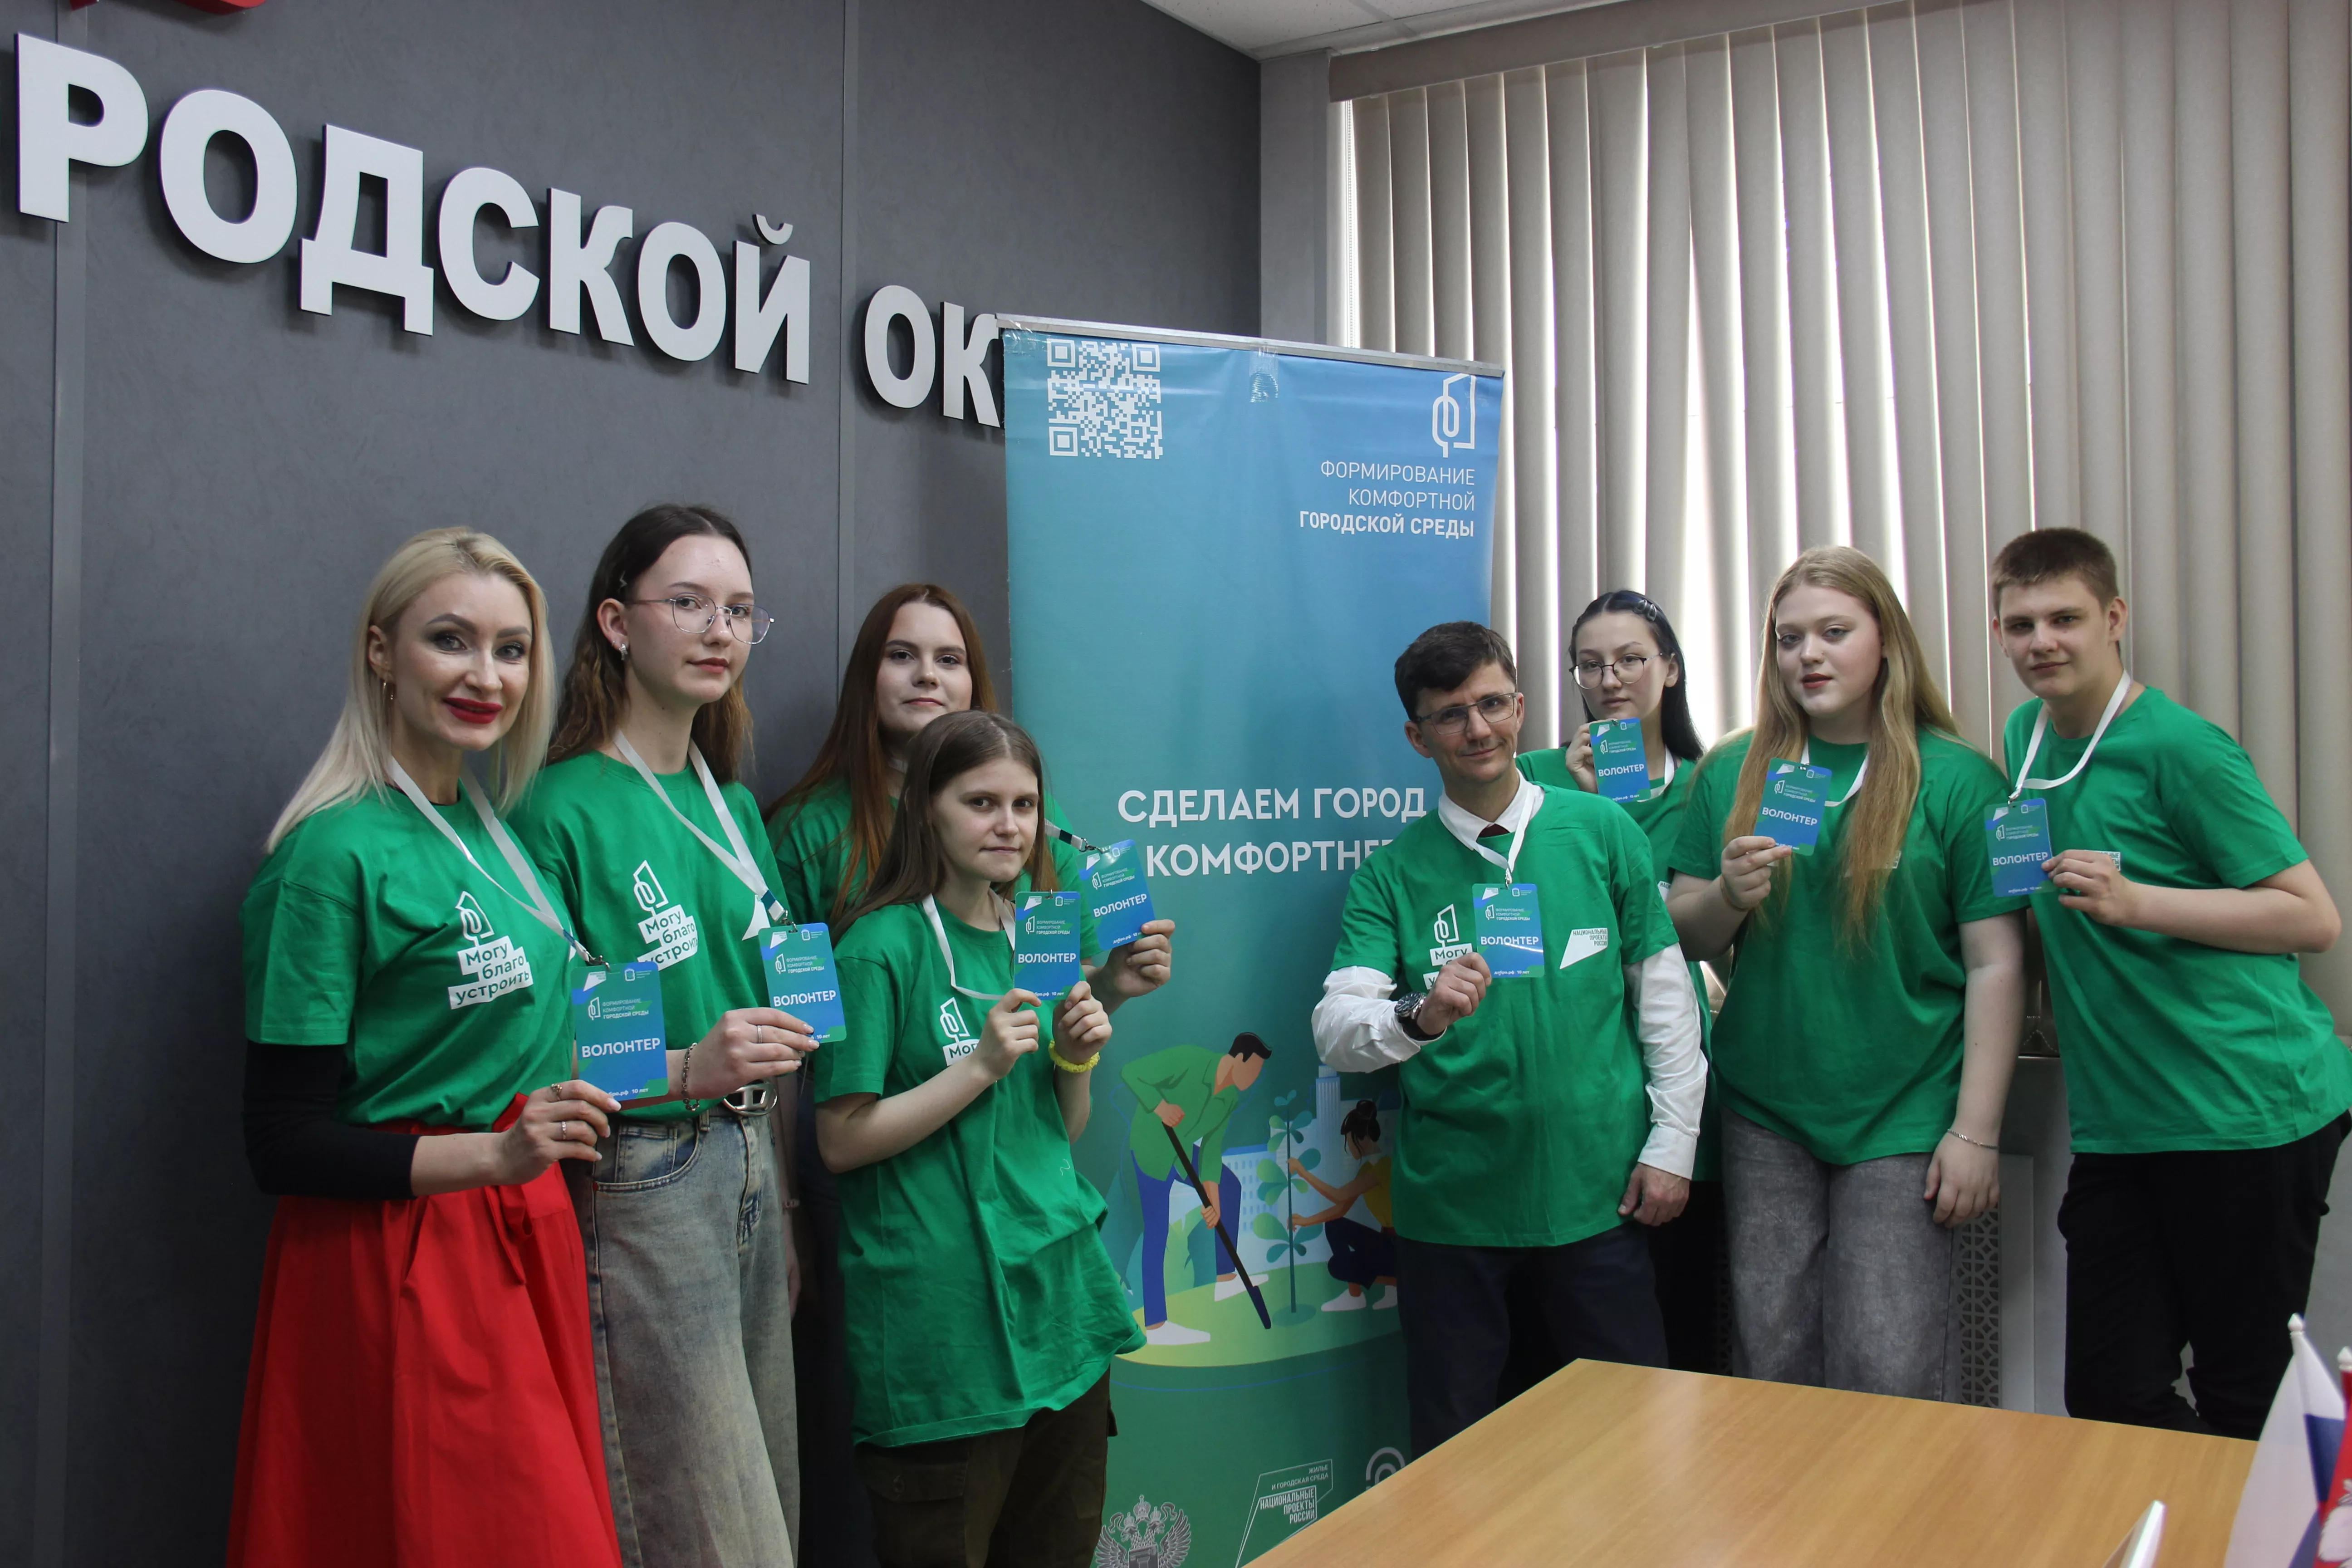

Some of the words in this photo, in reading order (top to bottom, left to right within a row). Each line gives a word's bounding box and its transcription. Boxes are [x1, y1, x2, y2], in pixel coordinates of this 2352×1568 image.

[16, 32, 810, 384] РОДСКОЙ
[1321, 460, 1475, 485] ФОРМИРОВАНИЕ
[1349, 488, 1475, 511] КОМФОРТНОЙ
[1300, 510, 1404, 535] ГОРОДСКОЙ
[1411, 517, 1474, 539] СРЕДЫ
[1598, 764, 1644, 777] ВОЛОНТЕР
[1118, 788, 1299, 828] СДЕЛАЕМ
[1314, 787, 1426, 823] ГОРОД
[1762, 807, 1818, 826] ВОЛОНТЕР
[1147, 839, 1393, 877] КОМФОРТНЕ
[1992, 852, 2048, 866] ВОЛОНТЕР
[1093, 893, 1147, 917] ВОЛОНТЕР
[645, 911, 681, 935] Могу
[662, 923, 695, 944] благо
[1480, 936, 1539, 945] ВОЛОНТЕР
[466, 943, 507, 966] Могу
[1018, 953, 1076, 963] ВОЛОНТЕР
[482, 956, 524, 979] благо
[456, 971, 529, 1005] устроить
[773, 990, 836, 1007] ВОЛОНТЕР
[582, 1038, 661, 1058] ВОЛОНТЕР
[949, 1044, 978, 1058] Мог
[1308, 1464, 1328, 1474] ЖИЛЬЕ
[1277, 1477, 1309, 1489] ГОРОДСКАЯ
[1310, 1473, 1328, 1481] СРЕДА
[1260, 1488, 1314, 1510] НАЦИОНАЛЬНЫЕ
[1284, 1499, 1314, 1515] ПРОЕКТЫ
[1289, 1509, 1315, 1524] РОССИИ
